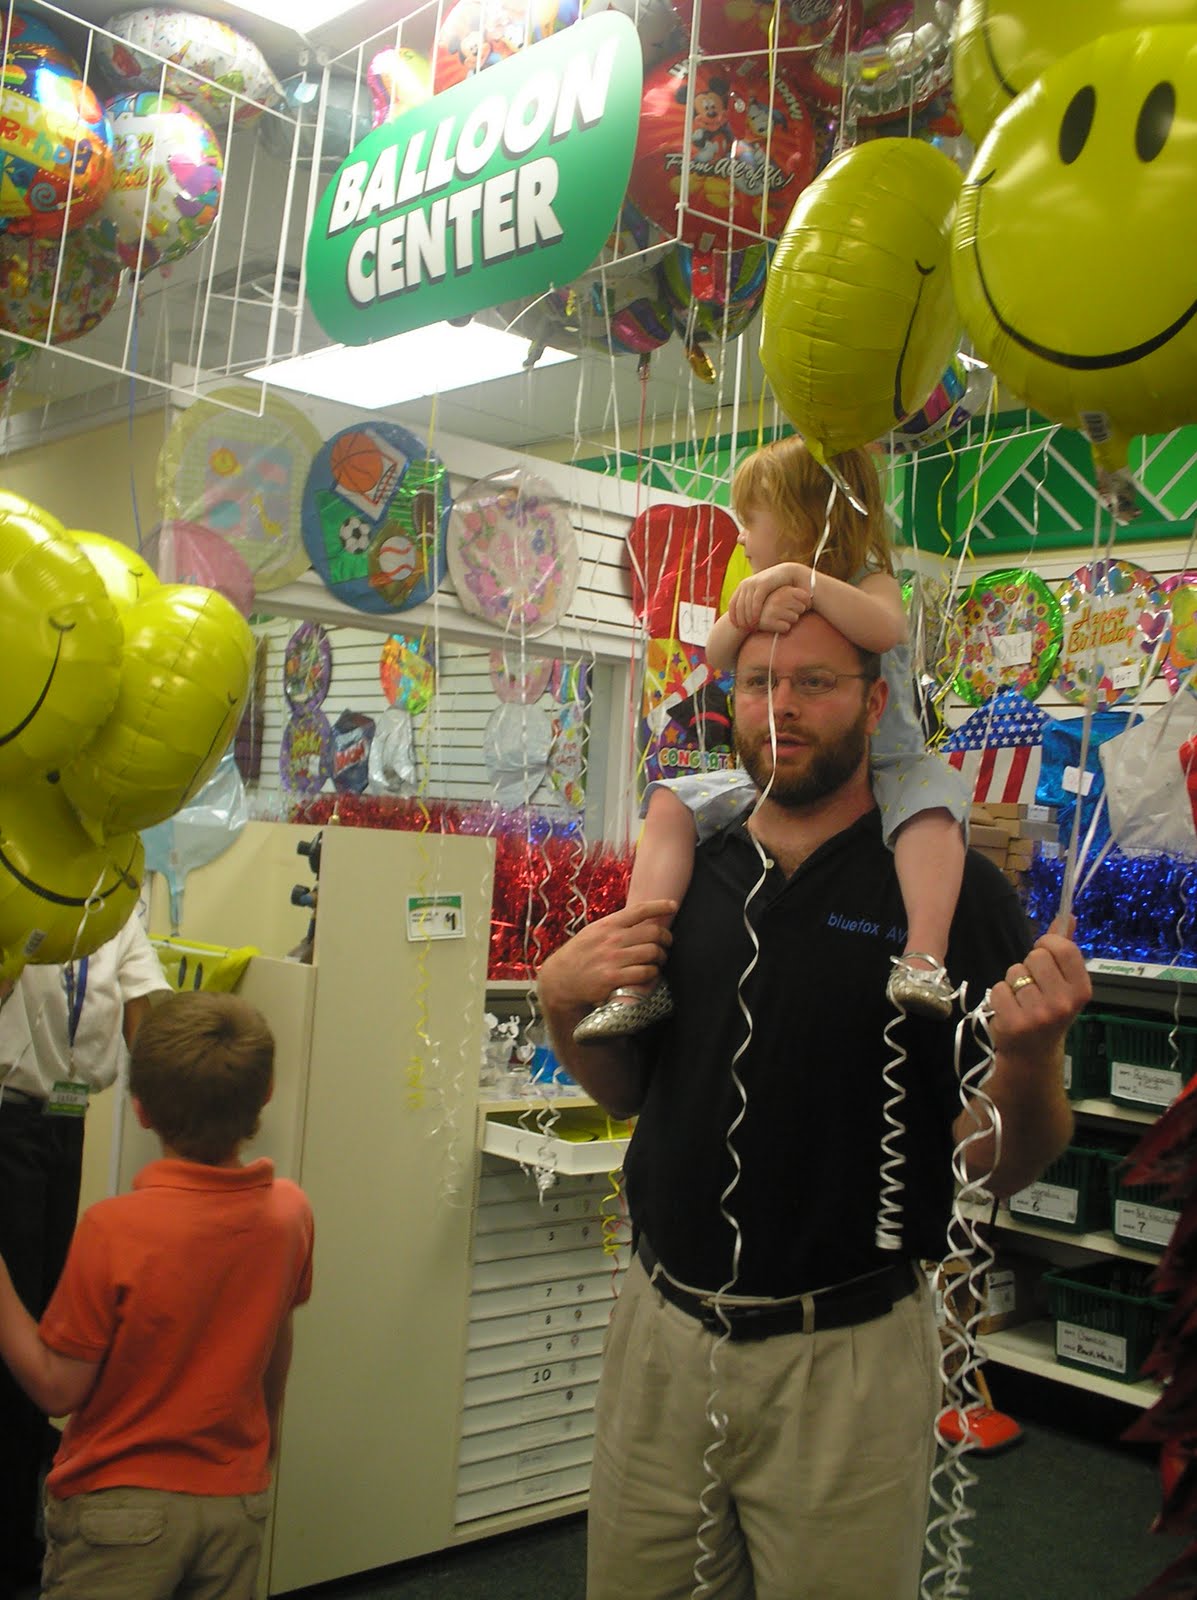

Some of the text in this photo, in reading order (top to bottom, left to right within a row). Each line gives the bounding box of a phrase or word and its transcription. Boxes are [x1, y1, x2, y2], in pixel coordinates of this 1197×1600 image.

[327, 36, 618, 238] BALLOON
[346, 156, 564, 309] CENTER
[1071, 605, 1129, 633] Happy
[1067, 626, 1137, 655] Birthday
[827, 911, 880, 936] bluefox
[531, 1368, 553, 1384] 10
